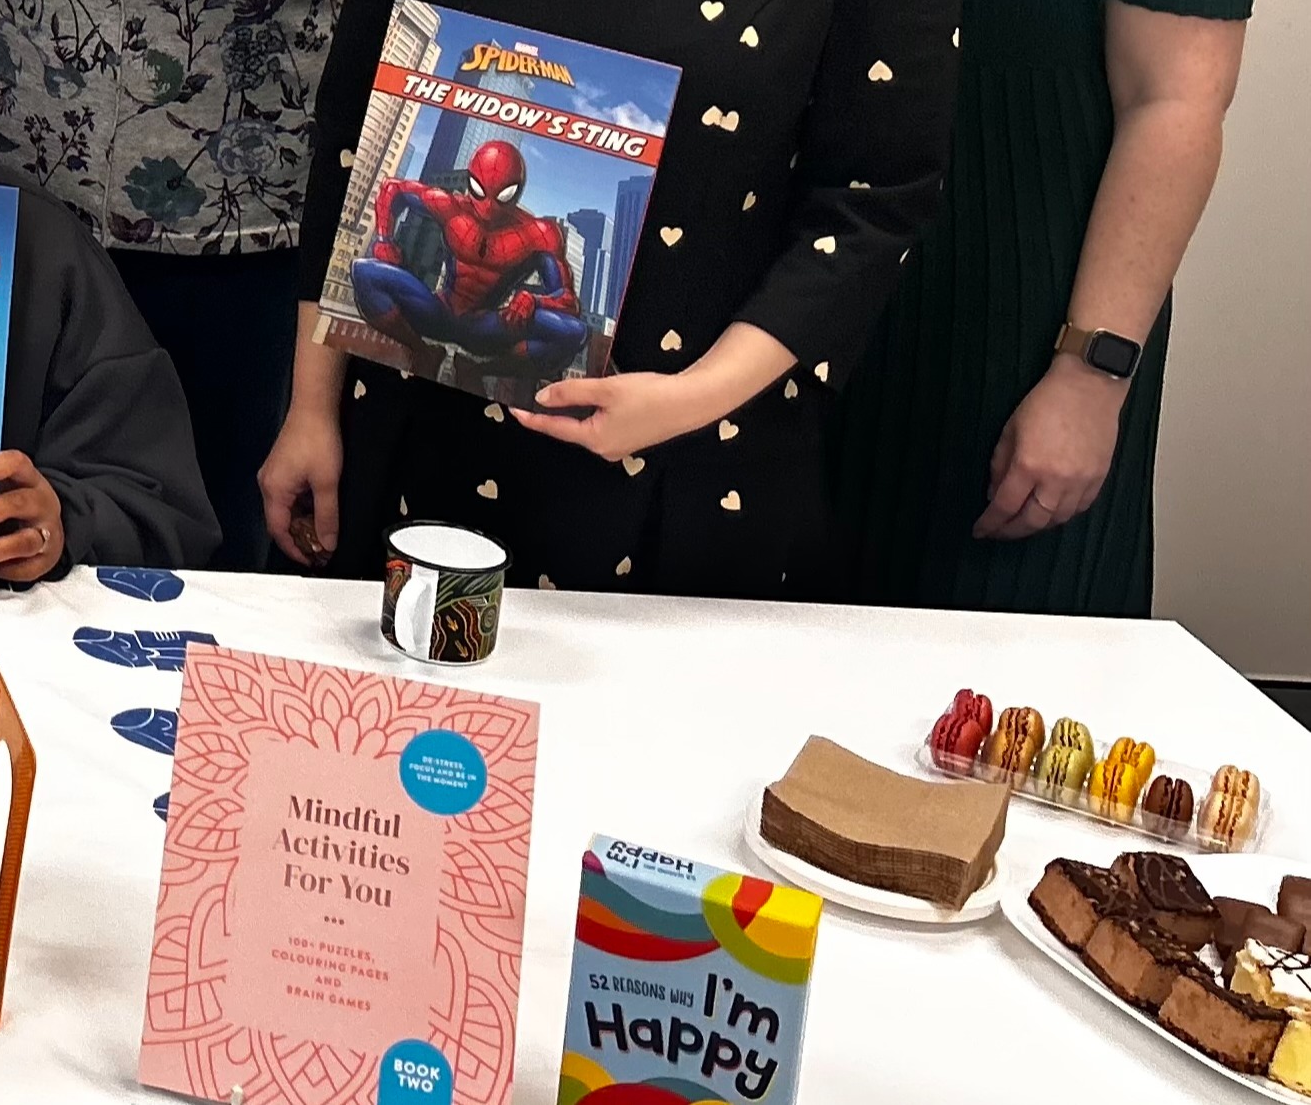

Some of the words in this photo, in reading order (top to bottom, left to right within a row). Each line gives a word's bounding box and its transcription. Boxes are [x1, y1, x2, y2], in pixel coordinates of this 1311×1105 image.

[460, 43, 576, 87] SPIDER-MAN
[402, 74, 453, 105] THE
[452, 82, 570, 137] WIDOW'S
[567, 120, 650, 159] STING
[287, 794, 402, 840] Mindful
[271, 827, 412, 877] Activities
[283, 862, 334, 896] For
[339, 873, 393, 909] You
[271, 948, 348, 974] COLOURING
[349, 964, 391, 983] PAGES
[318, 940, 377, 965] PUZZLES,
[286, 983, 326, 1002] BRAIN
[328, 993, 372, 1013] GAMES
[315, 974, 343, 989] AND
[589, 973, 610, 991] 52
[612, 975, 666, 1002] REASONS
[669, 988, 695, 1009] WHY
[703, 972, 780, 1045] I'm
[393, 1057, 441, 1081] BOOK
[583, 1000, 779, 1101] Happy
[397, 1073, 434, 1094] TWO
